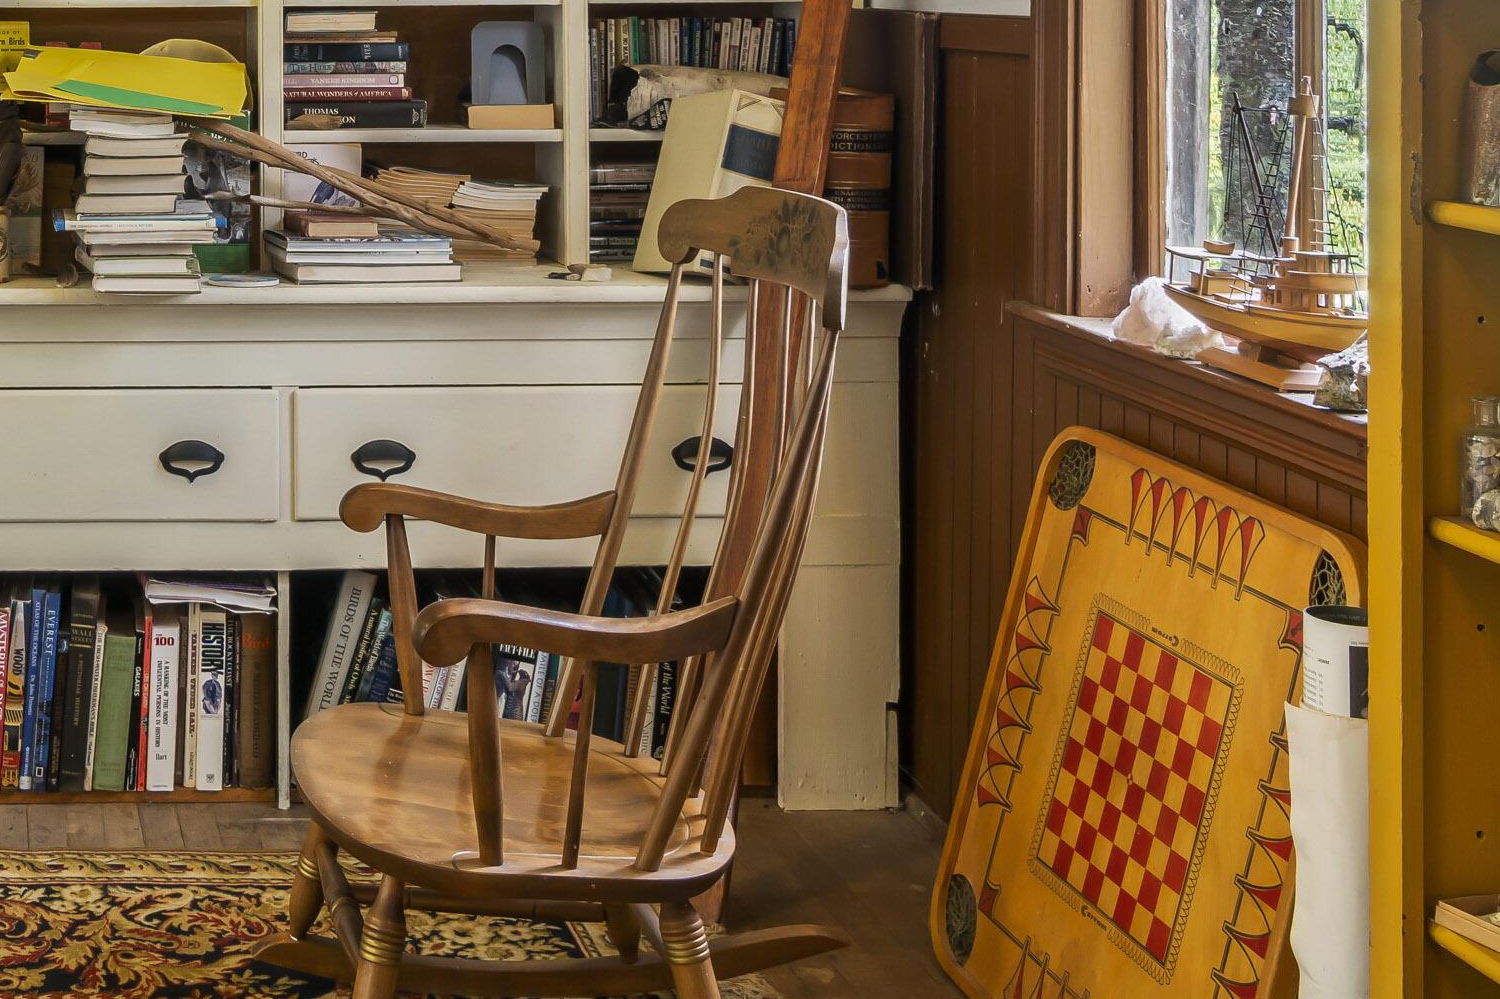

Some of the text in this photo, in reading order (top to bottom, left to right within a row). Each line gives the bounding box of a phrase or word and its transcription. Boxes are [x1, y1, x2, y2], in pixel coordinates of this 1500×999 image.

[8, 37, 25, 45] Birds
[45, 610, 55, 655] EVEREST
[154, 637, 174, 646] 100
[1151, 625, 1179, 647] Carrom
[12, 648, 24, 676] WOOD
[201, 622, 224, 675] HISTORY
[318, 587, 362, 712] BIRDS OF THE WORL
[133, 666, 141, 696] GALAXIES
[660, 661, 673, 715] of the World
[1080, 905, 1107, 931] Carrom
